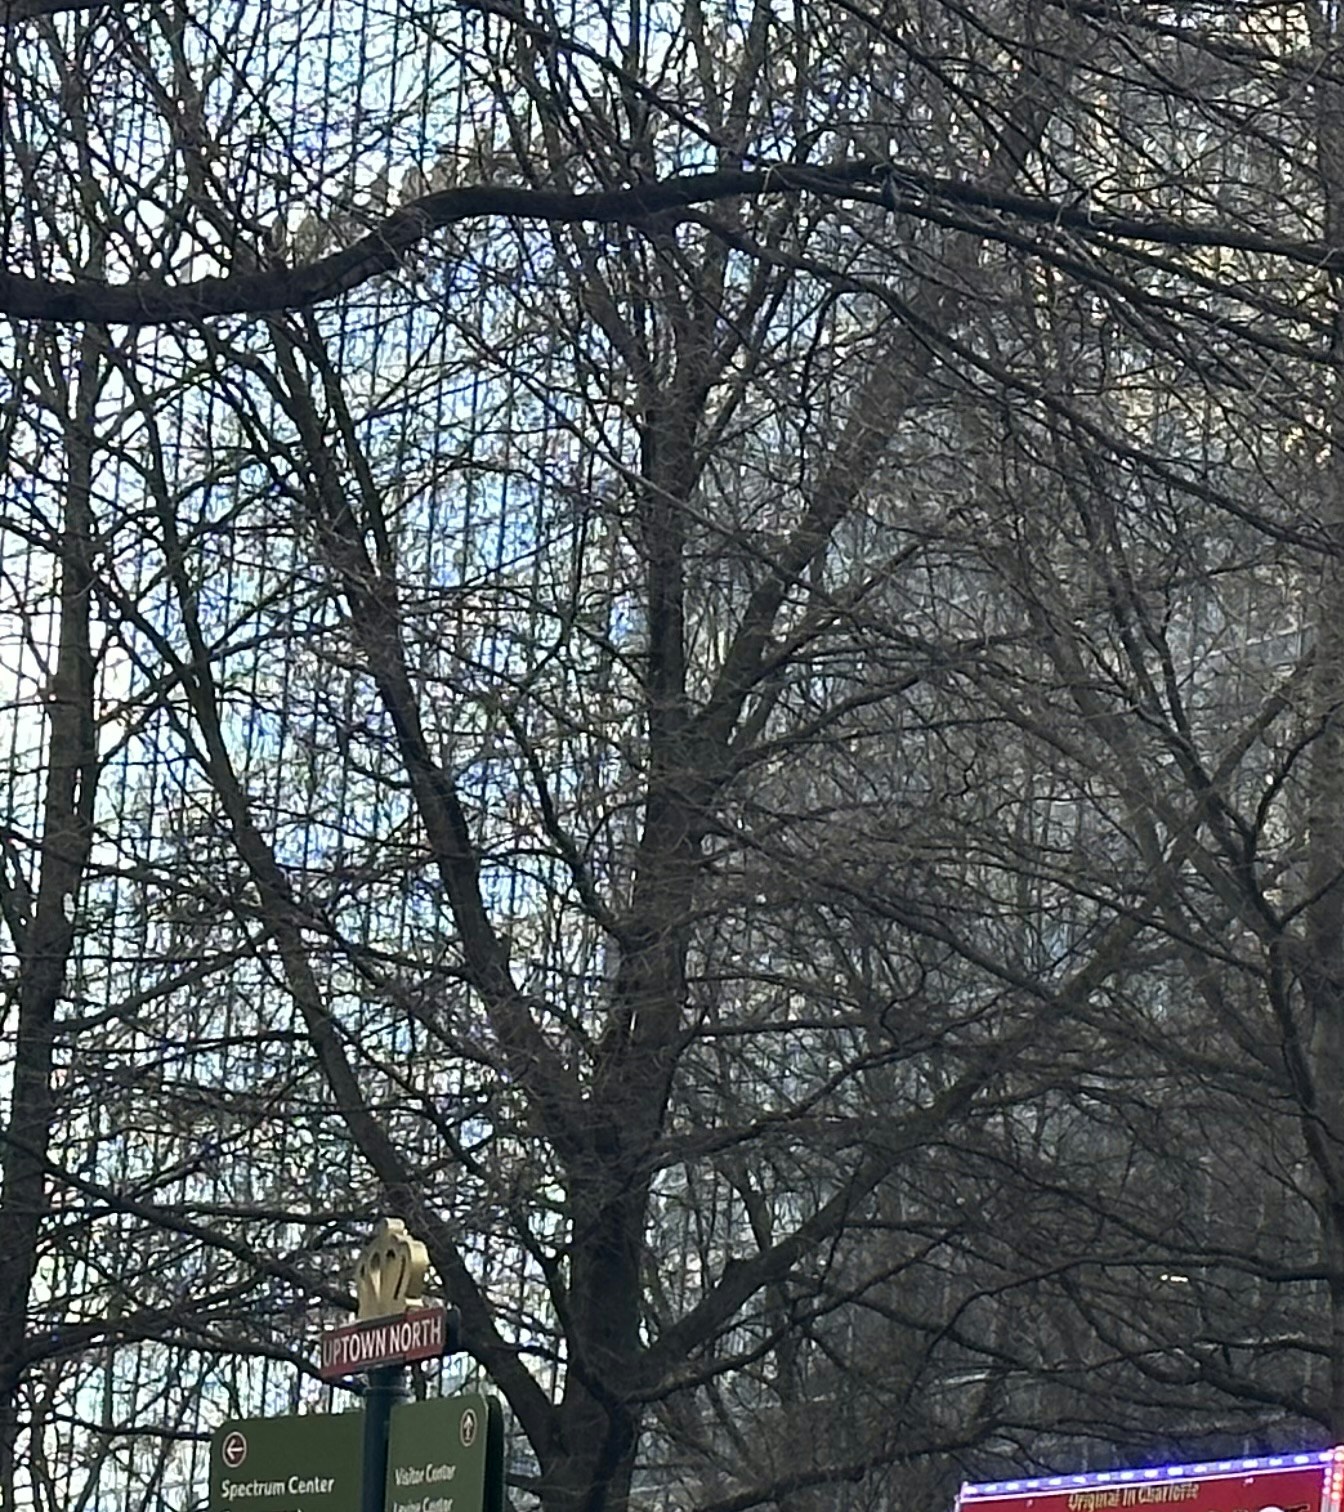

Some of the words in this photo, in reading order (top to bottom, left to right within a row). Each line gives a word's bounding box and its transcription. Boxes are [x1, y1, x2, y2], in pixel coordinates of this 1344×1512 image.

[322, 1327, 386, 1367] UPTOWN
[389, 1315, 442, 1354] NORTH
[221, 1478, 285, 1501] Spectrum
[288, 1476, 335, 1494] Center
[1068, 1491, 1119, 1512] Original
